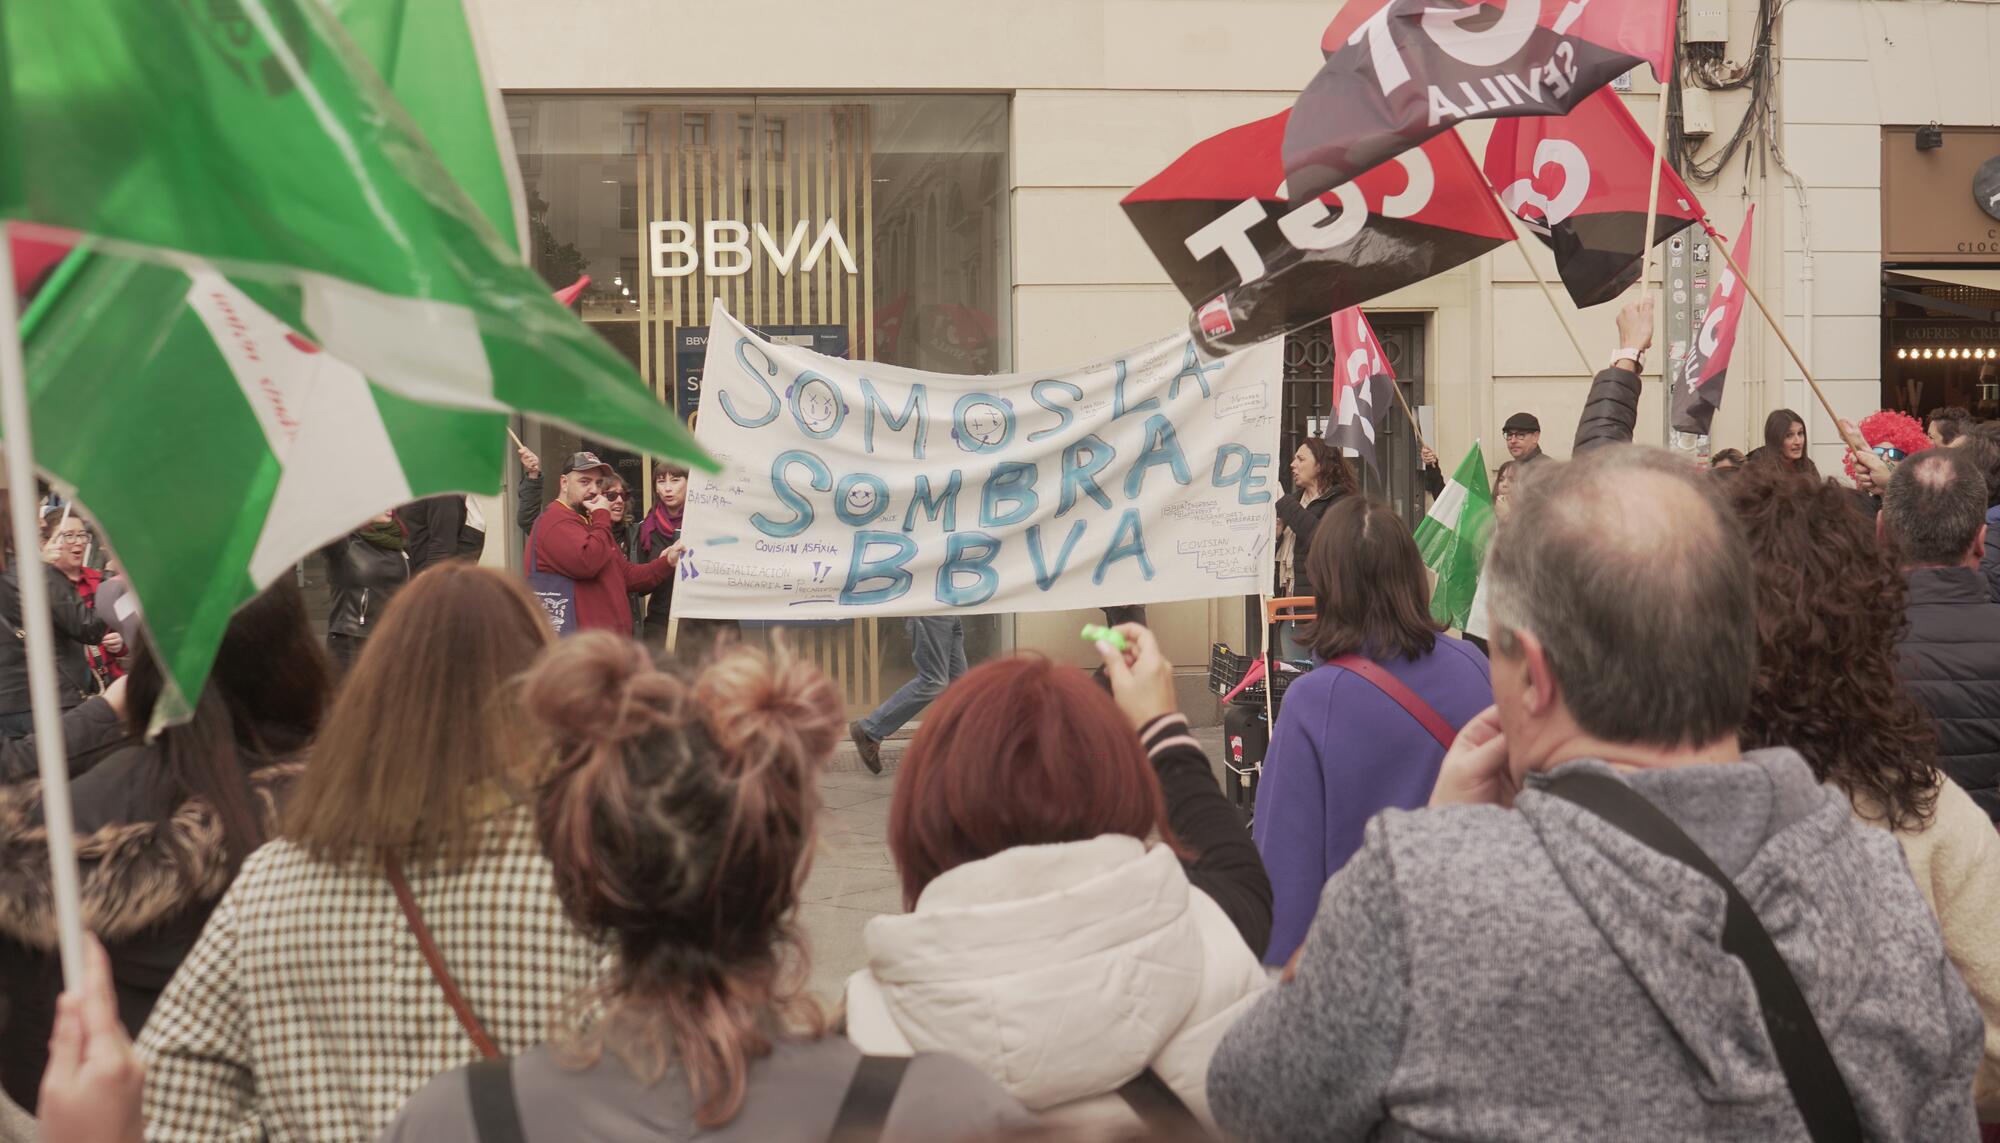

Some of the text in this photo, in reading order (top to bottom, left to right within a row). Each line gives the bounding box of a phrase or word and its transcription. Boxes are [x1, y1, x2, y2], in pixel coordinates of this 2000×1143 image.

[650, 217, 858, 277] BBVA
[1905, 327, 2000, 339] GOFRES CRE
[718, 337, 1226, 459] SOMOS LA
[749, 414, 1272, 538] SOMBRA DE
[755, 539, 839, 555] COVISIAN ASFIXIA
[839, 508, 1156, 606] BBVA
